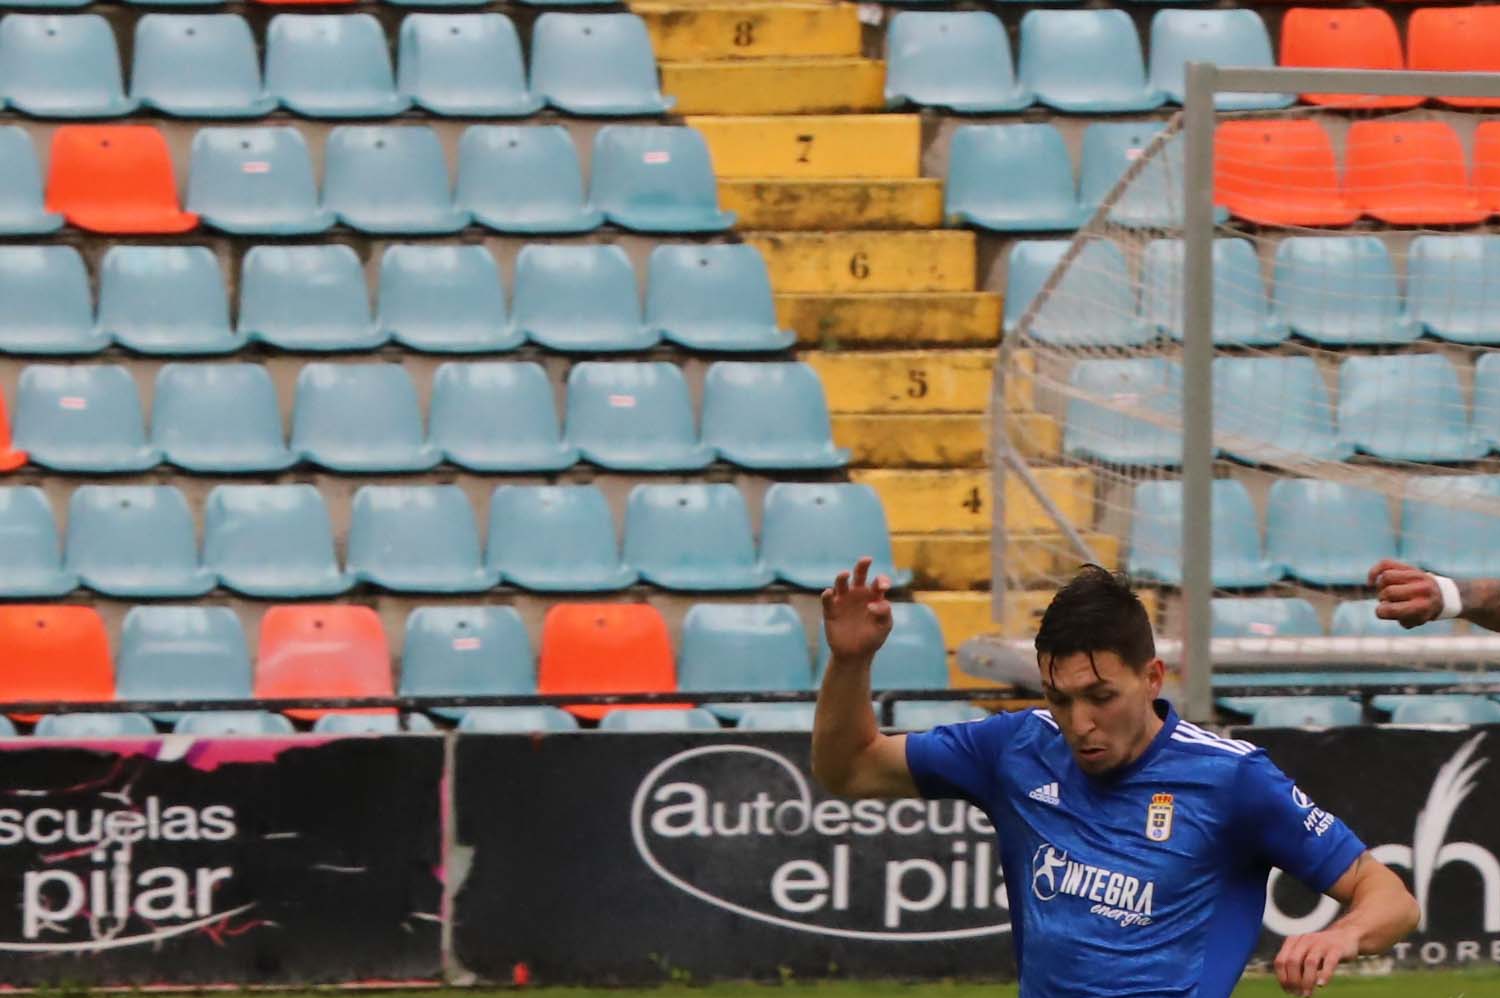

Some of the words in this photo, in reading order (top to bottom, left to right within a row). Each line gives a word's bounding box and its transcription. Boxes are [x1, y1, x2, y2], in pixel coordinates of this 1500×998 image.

[734, 22, 754, 46] 8
[796, 134, 814, 163] 7
[849, 253, 870, 279] 6
[907, 370, 928, 398] 5
[962, 487, 981, 514] 4
[23, 849, 233, 938] pilar
[771, 843, 849, 913] el
[884, 840, 1010, 928] pil
[1060, 861, 1154, 915] INTEGRA
